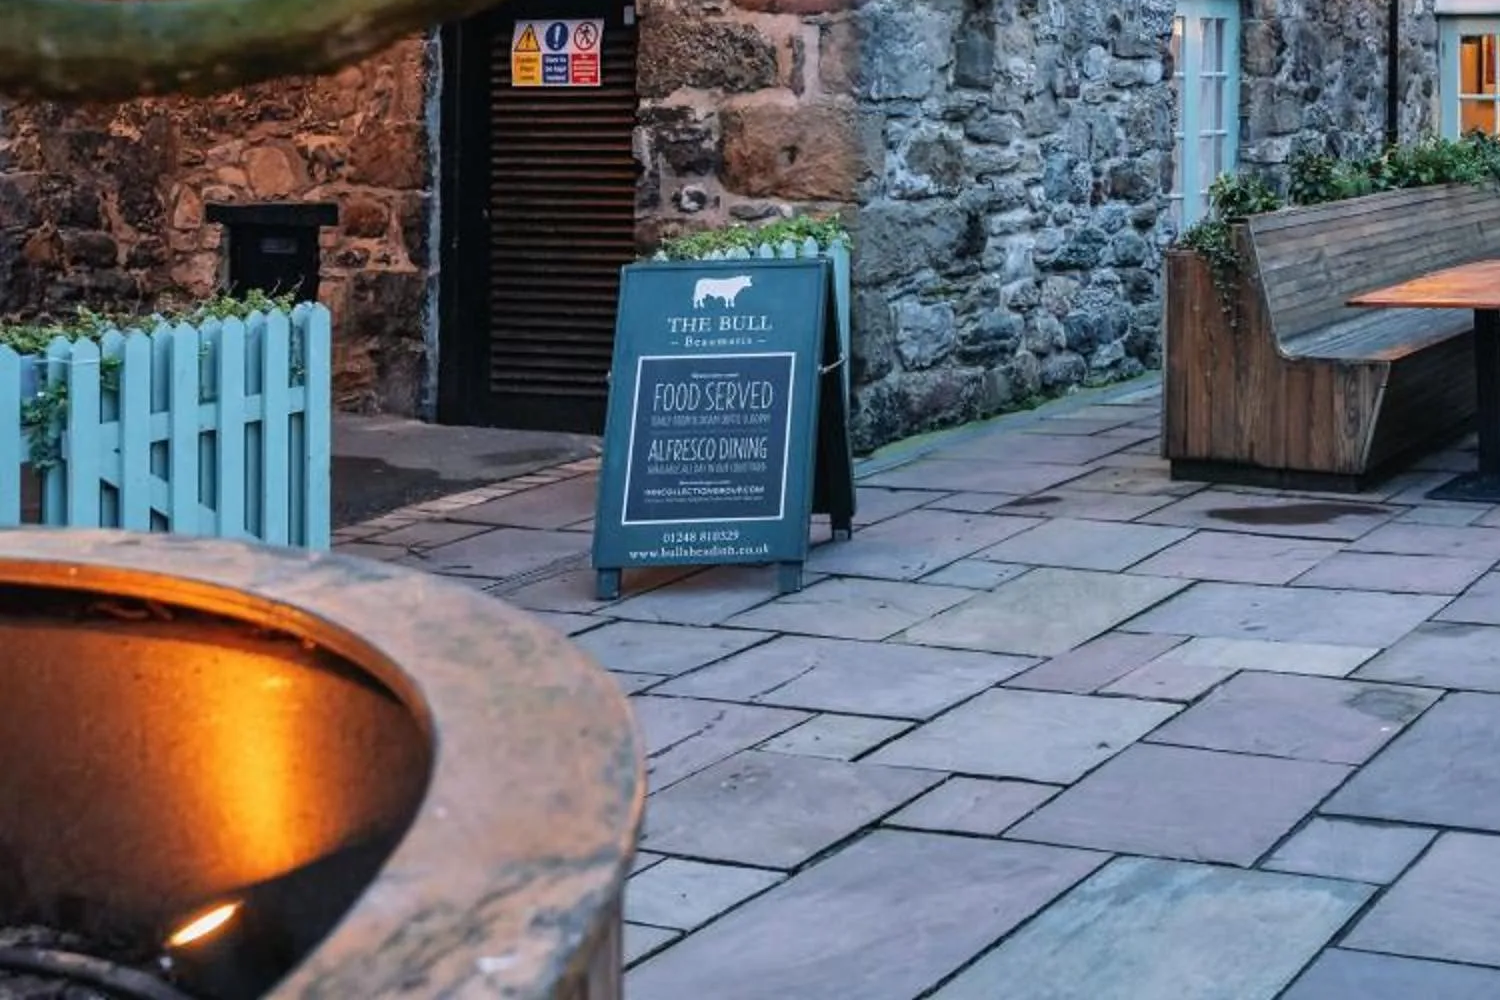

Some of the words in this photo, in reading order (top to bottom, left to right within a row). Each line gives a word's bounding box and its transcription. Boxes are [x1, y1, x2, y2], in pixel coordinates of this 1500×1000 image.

[667, 316, 712, 333] THE
[719, 315, 773, 332] BULL
[652, 382, 701, 412] FOOD
[704, 381, 774, 411] SERVED
[647, 438, 718, 462] ALFRESCO
[719, 436, 768, 460] DINING
[662, 531, 697, 543] 01248
